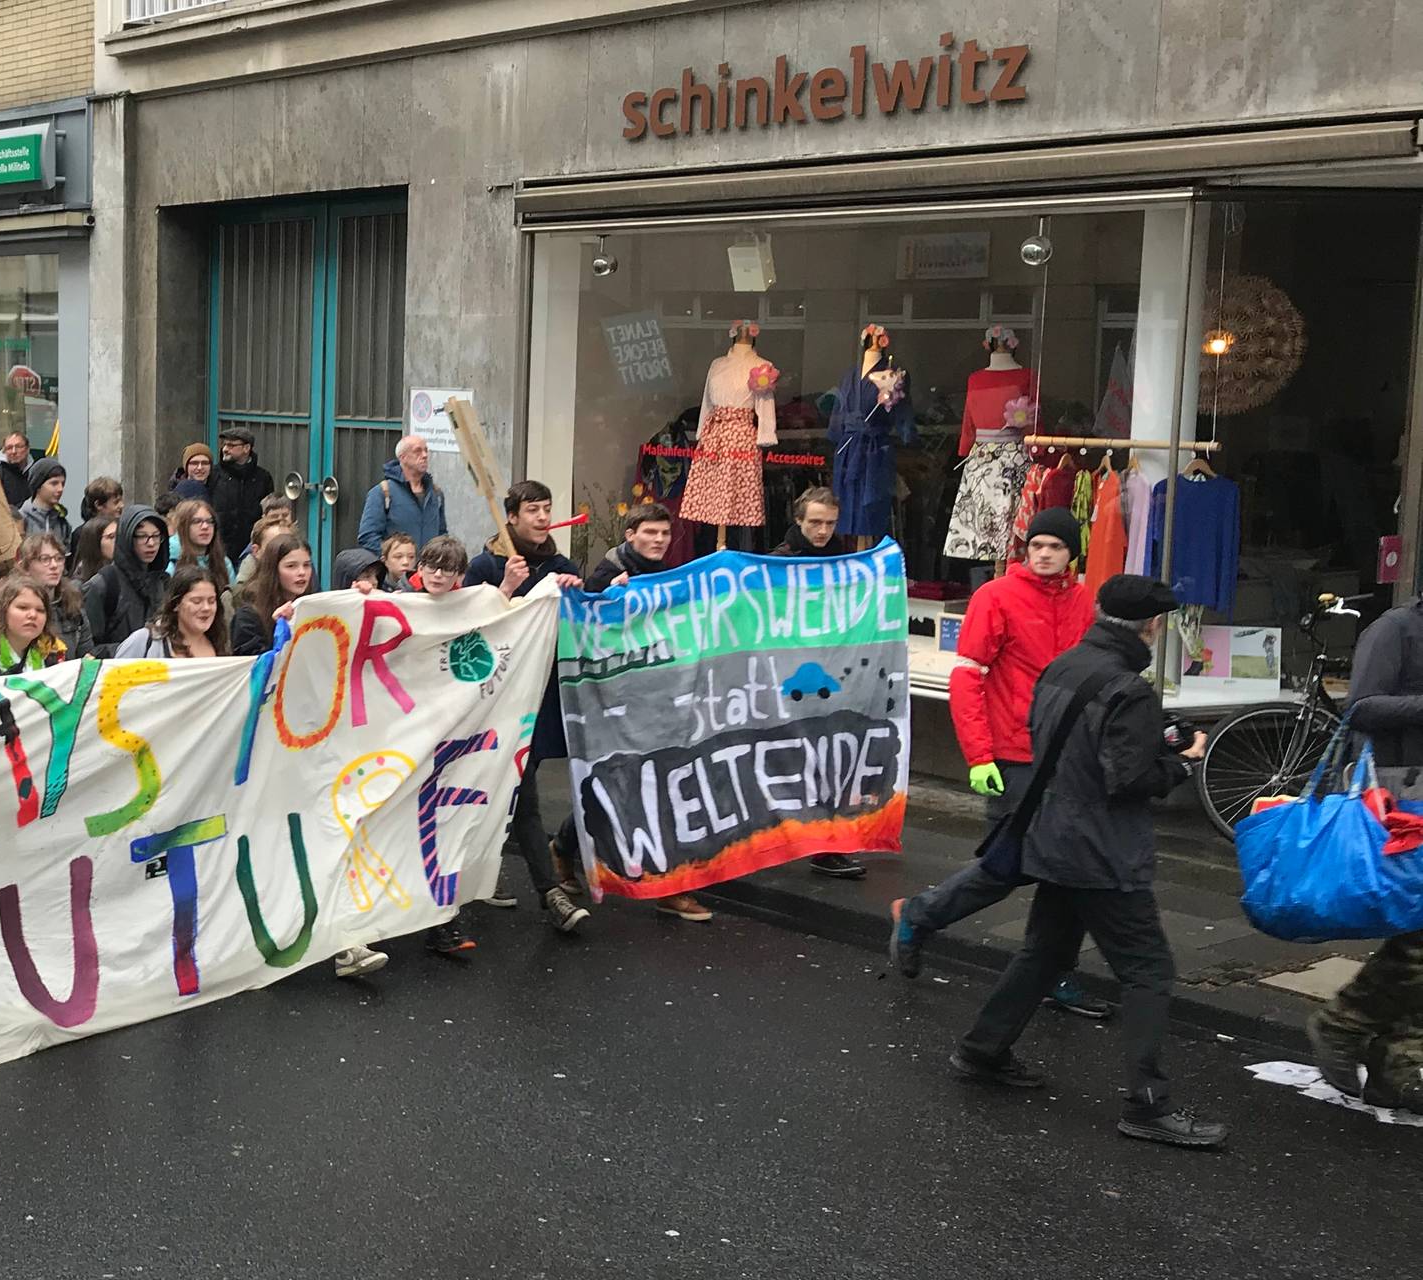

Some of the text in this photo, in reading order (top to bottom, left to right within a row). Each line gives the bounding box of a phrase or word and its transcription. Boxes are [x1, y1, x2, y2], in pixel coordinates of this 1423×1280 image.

[622, 32, 1030, 140] schinkelwitz
[8, 161, 30, 173] Militello
[765, 450, 826, 466] Accessoires
[565, 545, 902, 661] VERKEHRSWENDE
[233, 598, 417, 787] FOR
[689, 655, 790, 741] statt
[591, 726, 891, 878] WELTENDE
